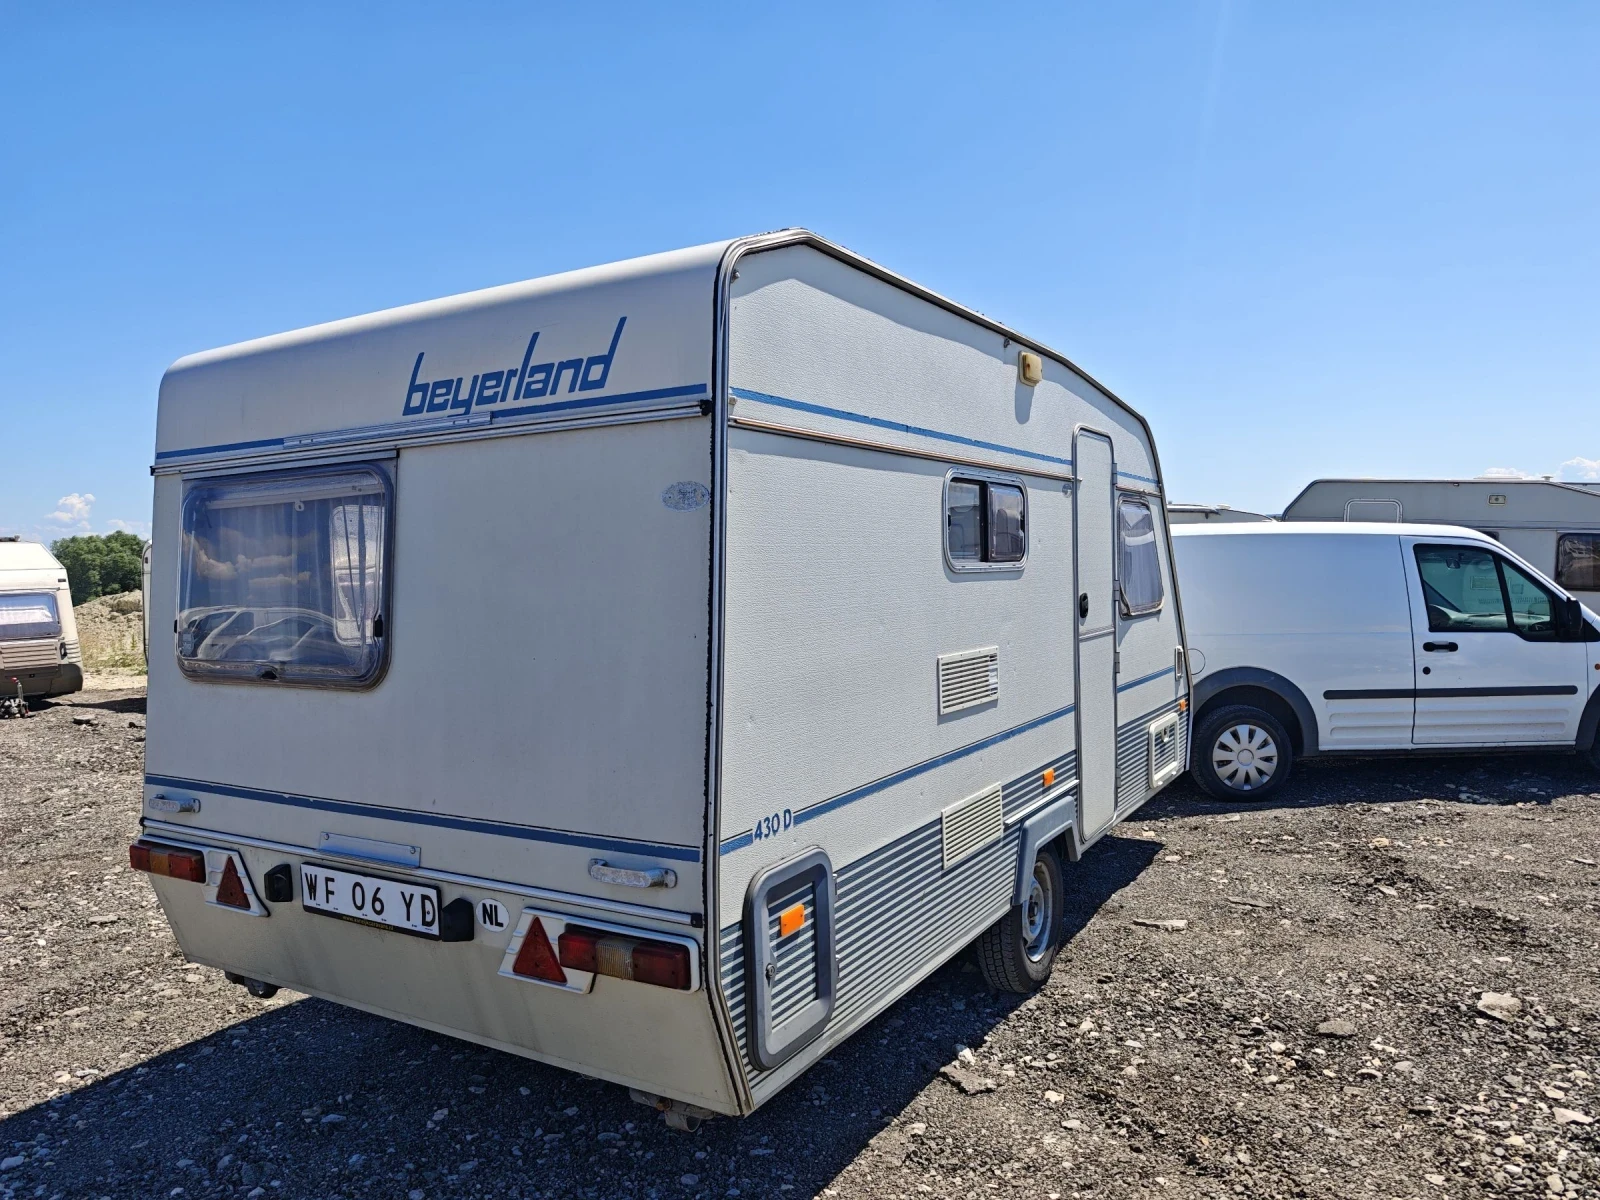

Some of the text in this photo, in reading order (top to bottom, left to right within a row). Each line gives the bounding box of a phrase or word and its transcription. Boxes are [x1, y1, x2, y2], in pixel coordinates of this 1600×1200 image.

[402, 316, 627, 417] beyerland
[754, 808, 792, 840] 430 D
[304, 872, 436, 927] WF 06 YD
[481, 902, 504, 928] NL
